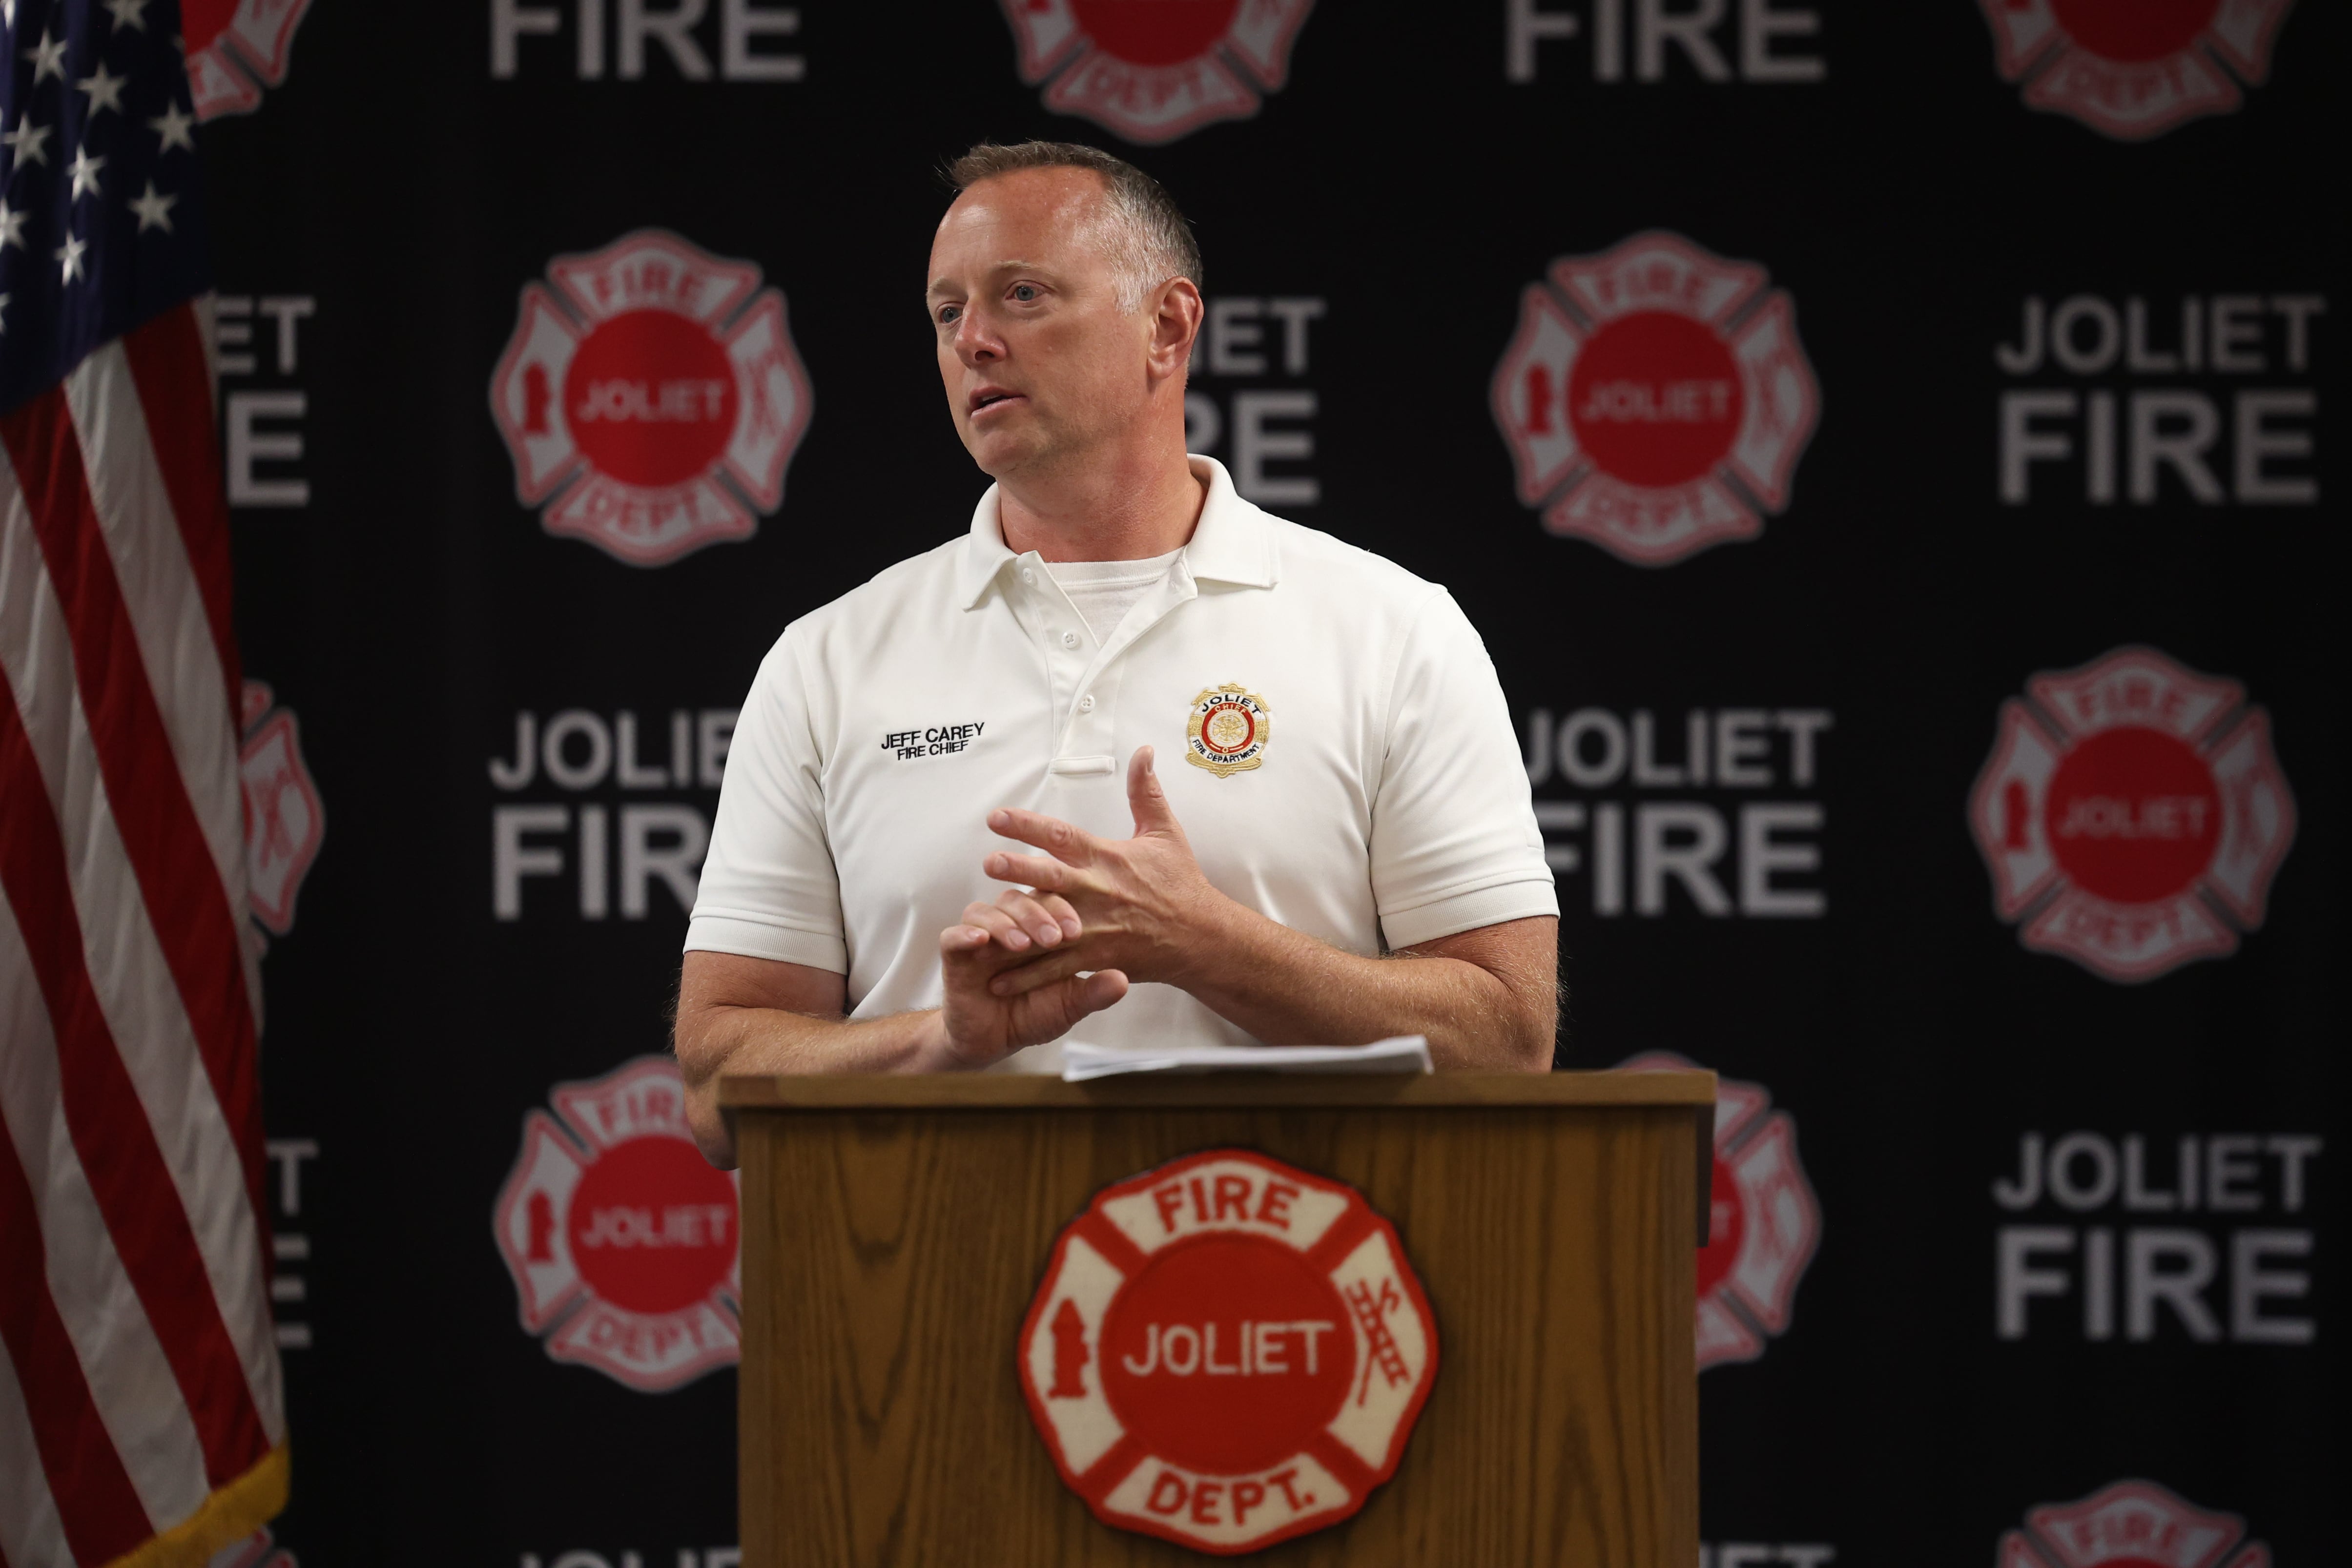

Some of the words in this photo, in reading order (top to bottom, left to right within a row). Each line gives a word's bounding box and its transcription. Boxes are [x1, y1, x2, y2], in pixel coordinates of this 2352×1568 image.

[491, 0, 805, 82] FIRE
[1504, 0, 1829, 83] FIRE
[592, 261, 706, 300] FIRE
[1594, 262, 1706, 300] FIRE
[1994, 293, 2326, 375] JOLIET
[577, 378, 726, 422] JOLIET
[1579, 378, 1732, 422] JOLIET
[1997, 388, 2319, 506] FIRE
[1202, 694, 1261, 714] JOLIET
[1215, 704, 1247, 714] CHIEF
[2076, 678, 2188, 718] FIRE
[487, 707, 741, 792] JOLIE
[881, 731, 921, 749] JEFF
[926, 722, 985, 743] CAREY
[897, 745, 926, 761] FIRE
[929, 740, 969, 755] CHIEF
[1193, 739, 1207, 755] FIRE
[1207, 744, 1259, 763] DEPARTMENT
[1524, 706, 1836, 790] JOLIET
[2056, 795, 2211, 841] JOLIET
[493, 802, 714, 922] FIR
[596, 1085, 680, 1132] FIR
[1990, 1129, 2323, 1215] JOLIET
[578, 1203, 732, 1249] JOLIET
[1153, 1176, 1300, 1233] FIRE
[1994, 1226, 2318, 1344] FIRE
[1122, 1321, 1334, 1376] JOLIET
[1144, 1469, 1316, 1527] DEPT.
